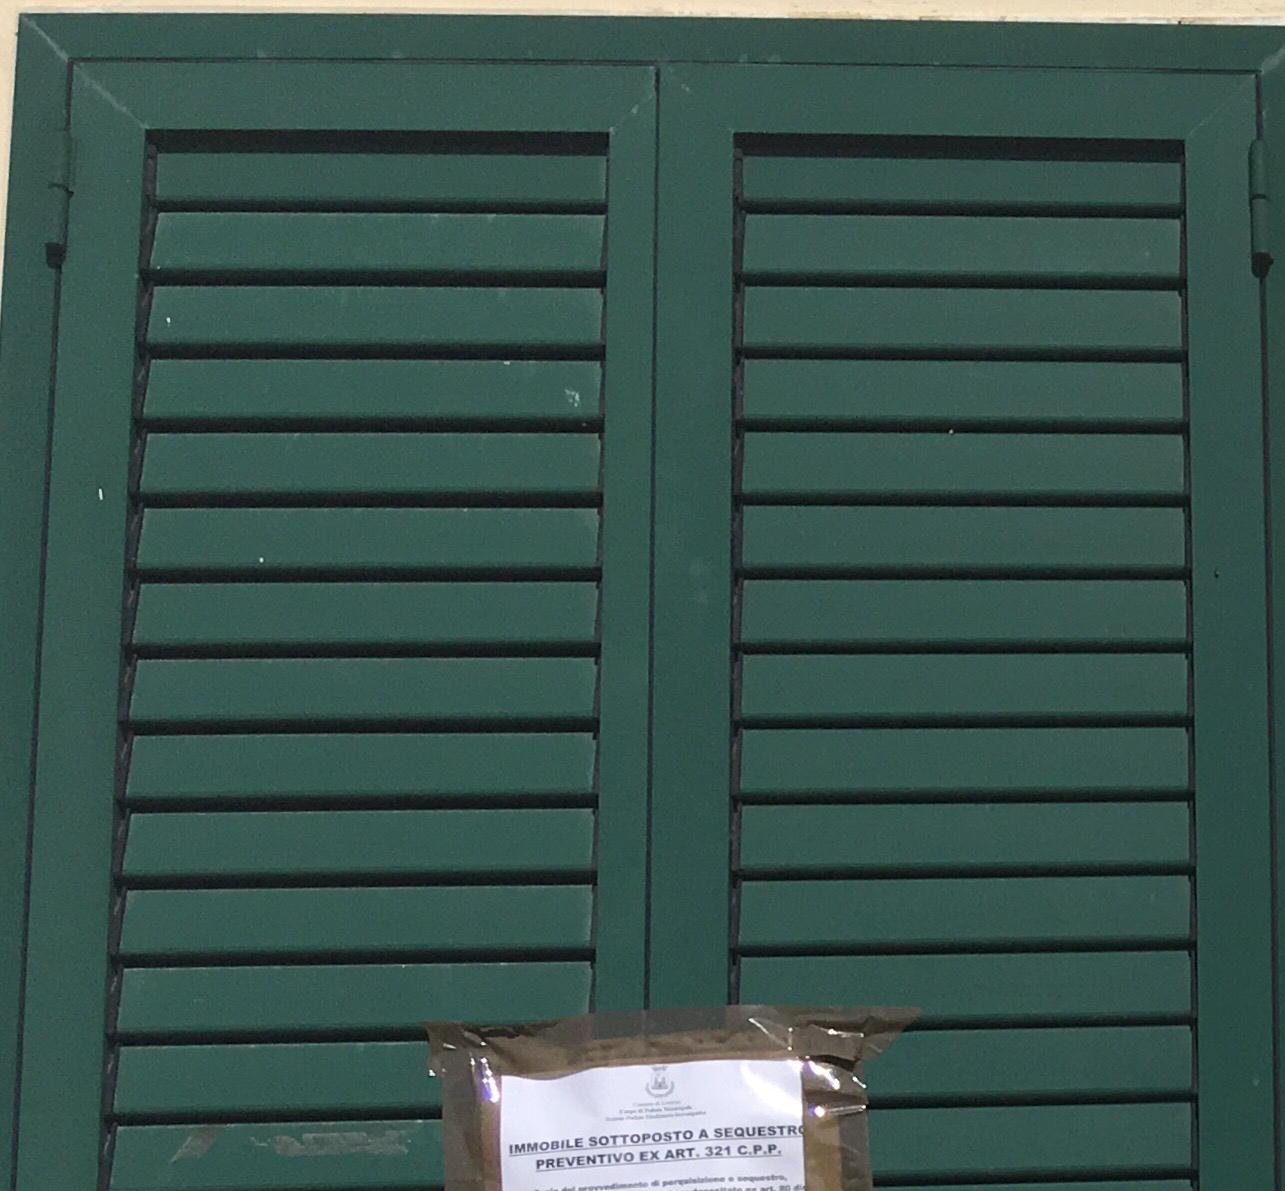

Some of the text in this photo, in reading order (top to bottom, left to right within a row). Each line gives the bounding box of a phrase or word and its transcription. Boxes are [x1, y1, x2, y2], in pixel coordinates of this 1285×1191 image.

[509, 1138, 583, 1154] IMMOBILE
[588, 1130, 694, 1147] SOTTOPOSTO
[698, 1129, 709, 1139] A
[536, 1144, 782, 1169] PREVENTIVO EX ART. 321 C.P.P.
